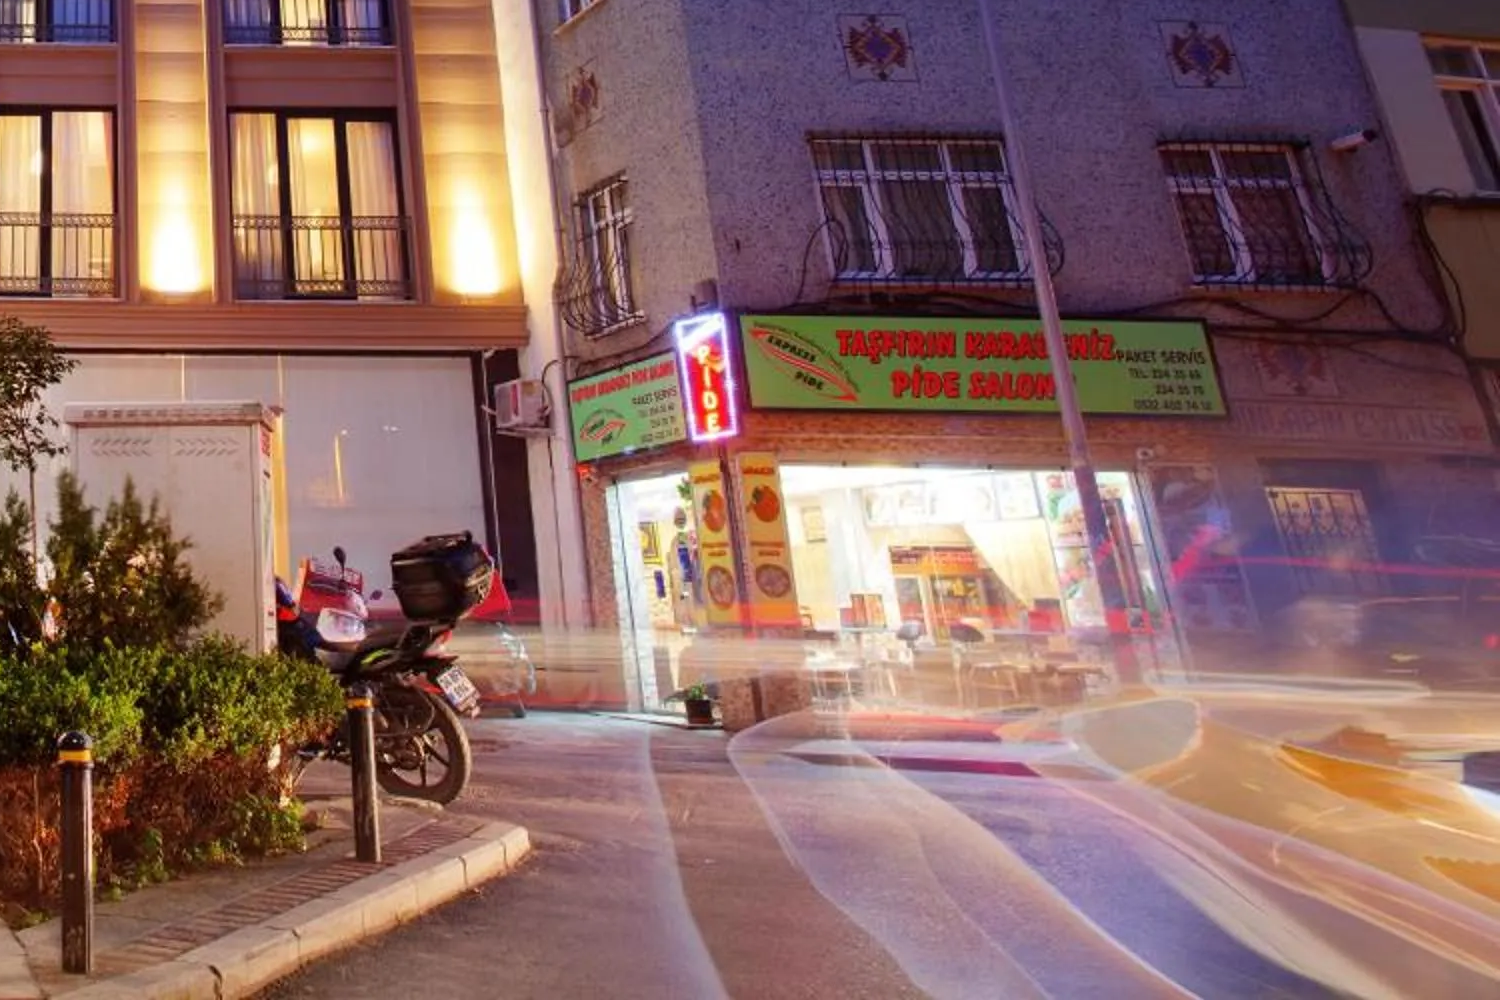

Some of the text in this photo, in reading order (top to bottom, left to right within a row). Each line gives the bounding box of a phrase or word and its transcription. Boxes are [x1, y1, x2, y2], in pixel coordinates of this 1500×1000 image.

[965, 328, 1116, 361] KARADNİZ
[890, 364, 960, 399] PİDE
[968, 371, 1076, 400] SALON
